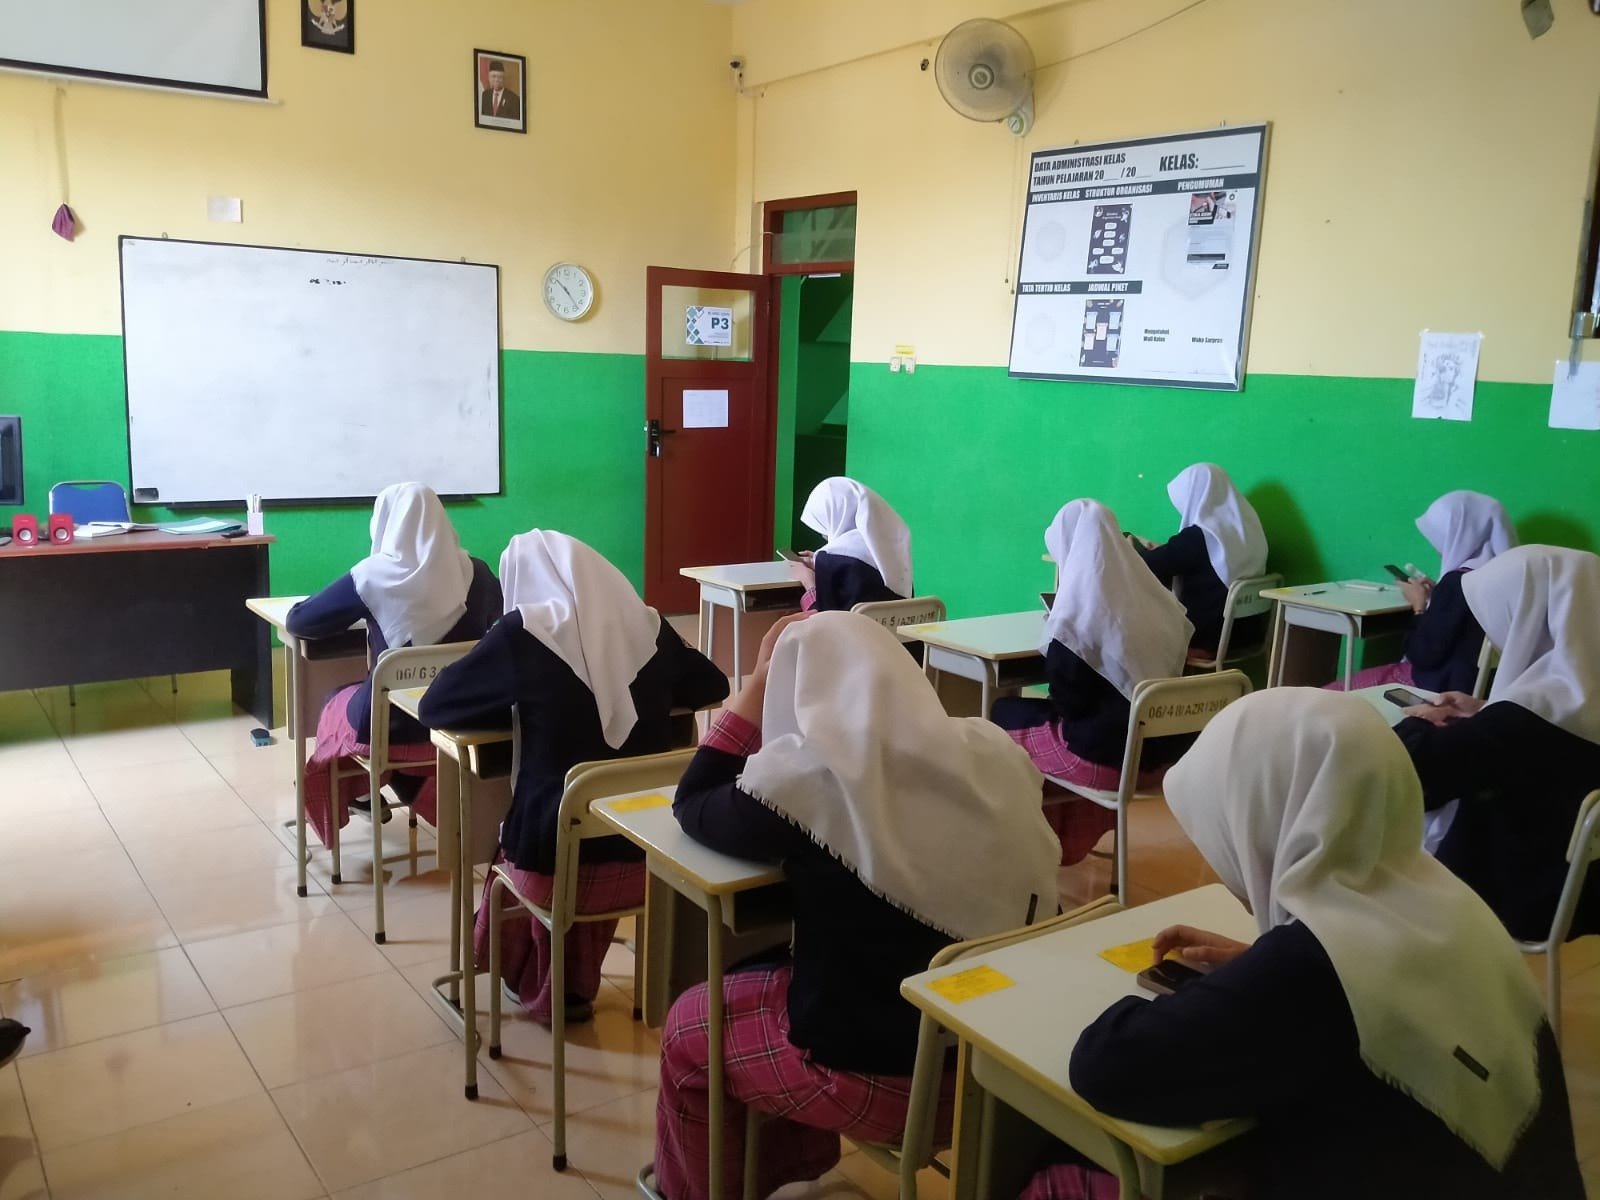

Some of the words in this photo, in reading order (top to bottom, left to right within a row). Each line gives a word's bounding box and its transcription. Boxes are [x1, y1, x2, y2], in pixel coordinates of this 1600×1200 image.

[1034, 161, 1050, 172] DATA
[1052, 155, 1102, 171] ADMINISTRASI
[1103, 153, 1126, 165] KELAS
[1159, 153, 1199, 172] KELAS:
[1033, 175, 1054, 186] TAHUN
[1055, 170, 1093, 185] PELAJARAN
[1177, 178, 1225, 191] PENGUMUMAN
[1031, 192, 1062, 203] INVENTARIS
[1063, 190, 1080, 200] KELAS
[1085, 186, 1115, 198] STRUKTUR
[1115, 184, 1153, 196] ORGANISASI
[1053, 283, 1071, 292] KELAS
[1088, 283, 1111, 292] JADWAL
[1111, 282, 1129, 292] PIKET
[711, 317, 729, 330] P3
